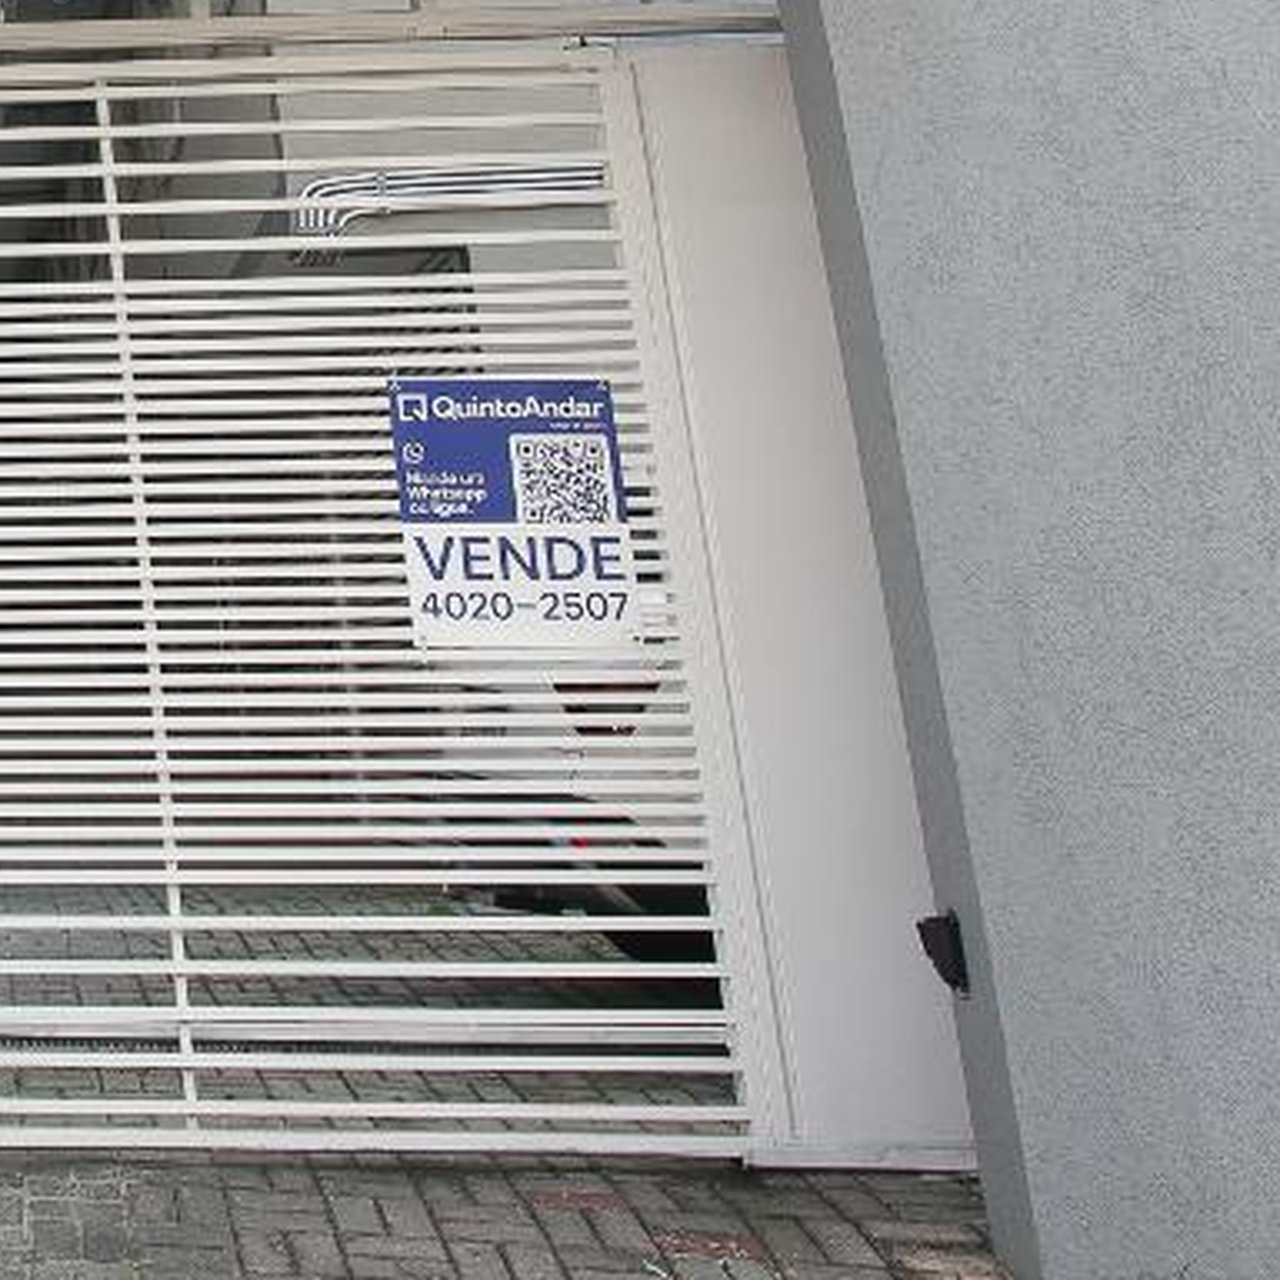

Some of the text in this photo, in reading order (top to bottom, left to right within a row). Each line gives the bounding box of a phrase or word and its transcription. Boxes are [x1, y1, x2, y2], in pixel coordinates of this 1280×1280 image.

[431, 395, 605, 421] QuintoAndar
[412, 536, 628, 581] VENDE
[421, 592, 629, 621] 4020-2507
